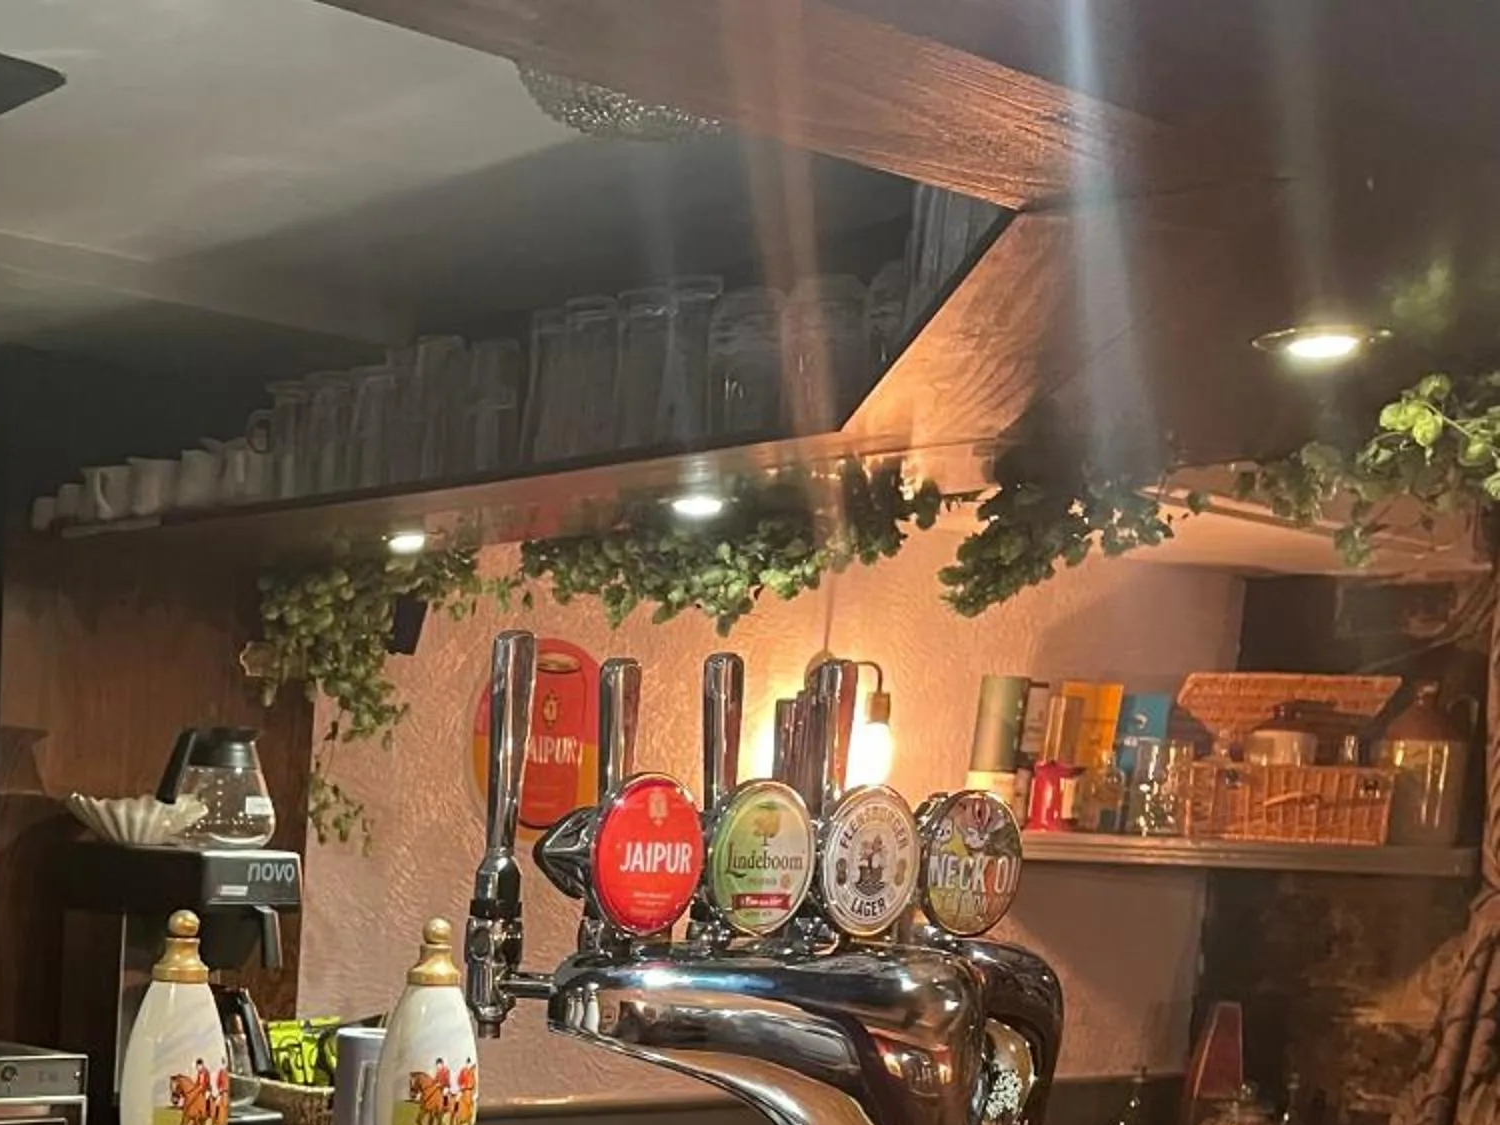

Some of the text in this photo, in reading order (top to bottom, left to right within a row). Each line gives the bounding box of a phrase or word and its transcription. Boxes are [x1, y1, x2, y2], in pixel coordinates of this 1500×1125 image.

[528, 735, 577, 765] AIPUR
[248, 863, 295, 883] novo
[619, 841, 693, 875] JAIPUR
[725, 844, 804, 878] Lindeboom
[928, 854, 986, 894] NECK
[851, 897, 886, 917] LAGER
